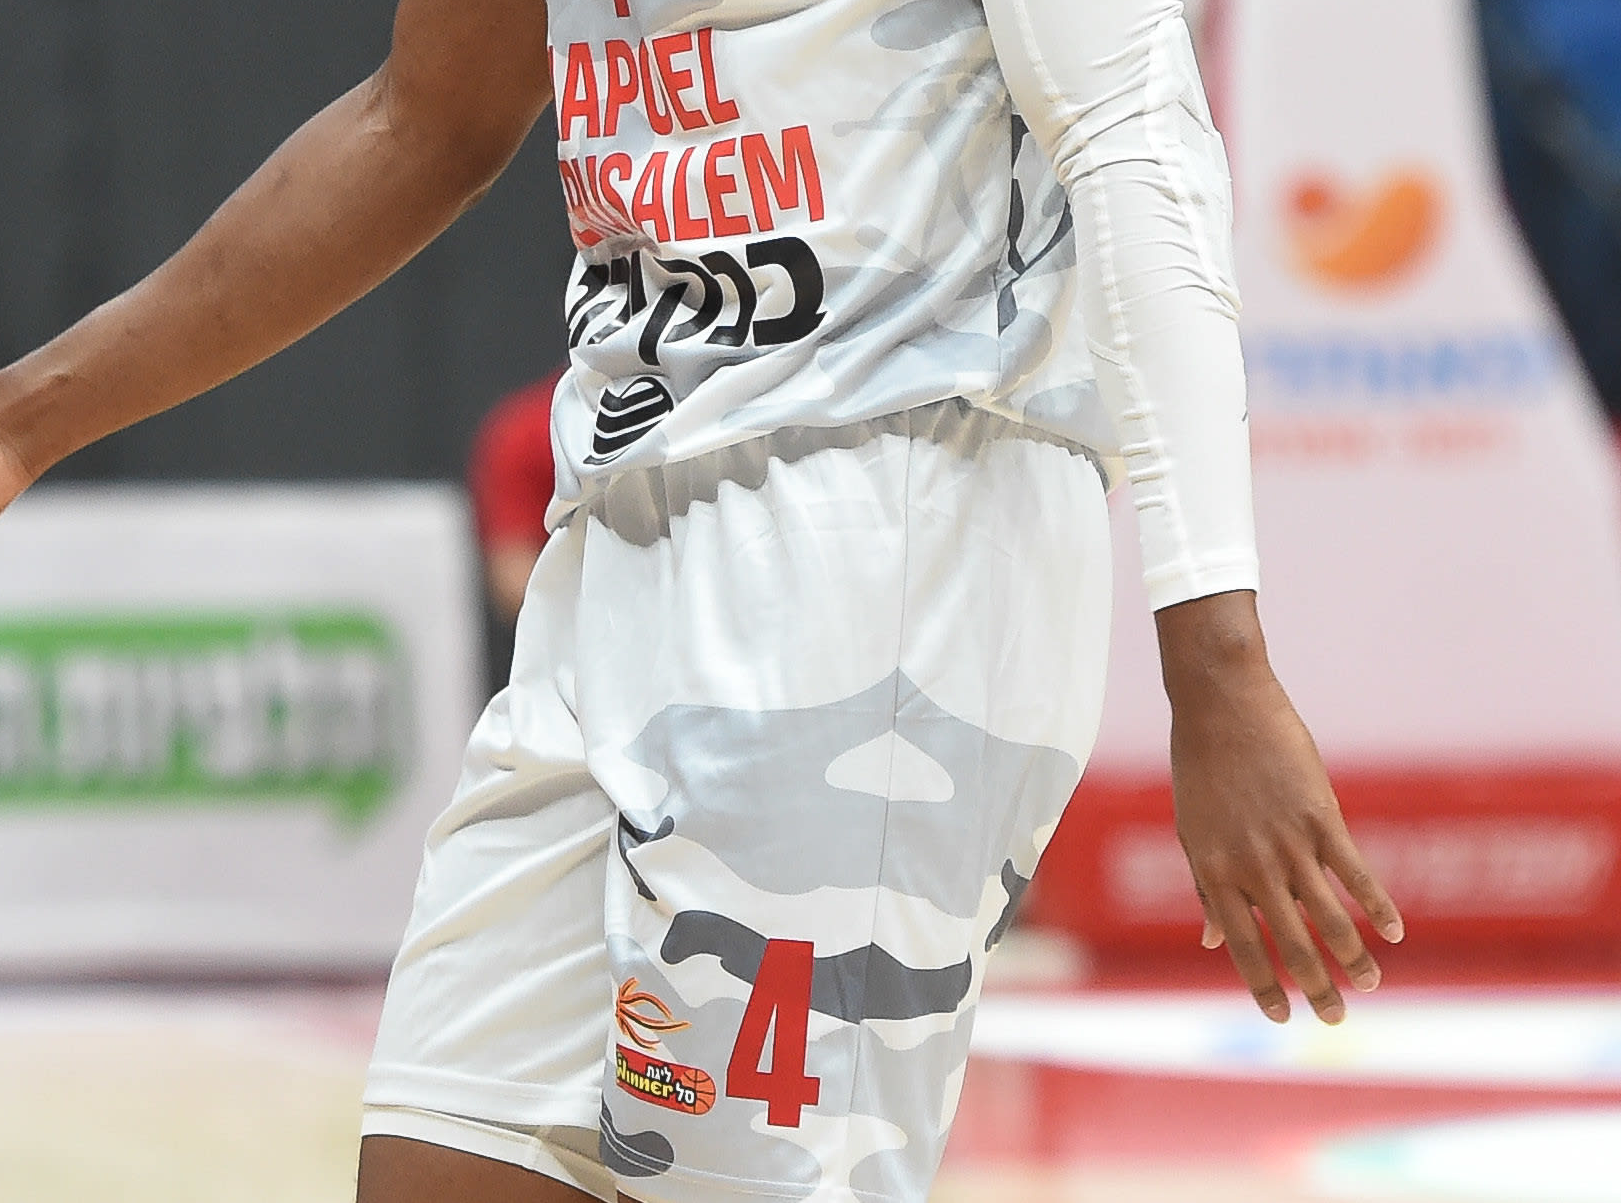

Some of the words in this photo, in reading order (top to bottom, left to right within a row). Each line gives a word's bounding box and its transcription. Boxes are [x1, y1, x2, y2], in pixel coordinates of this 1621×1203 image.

[548, 26, 741, 142] APOEL
[558, 125, 825, 246] RUSALEM
[726, 938, 820, 1128] 4
[675, 1081, 695, 1104] סל
